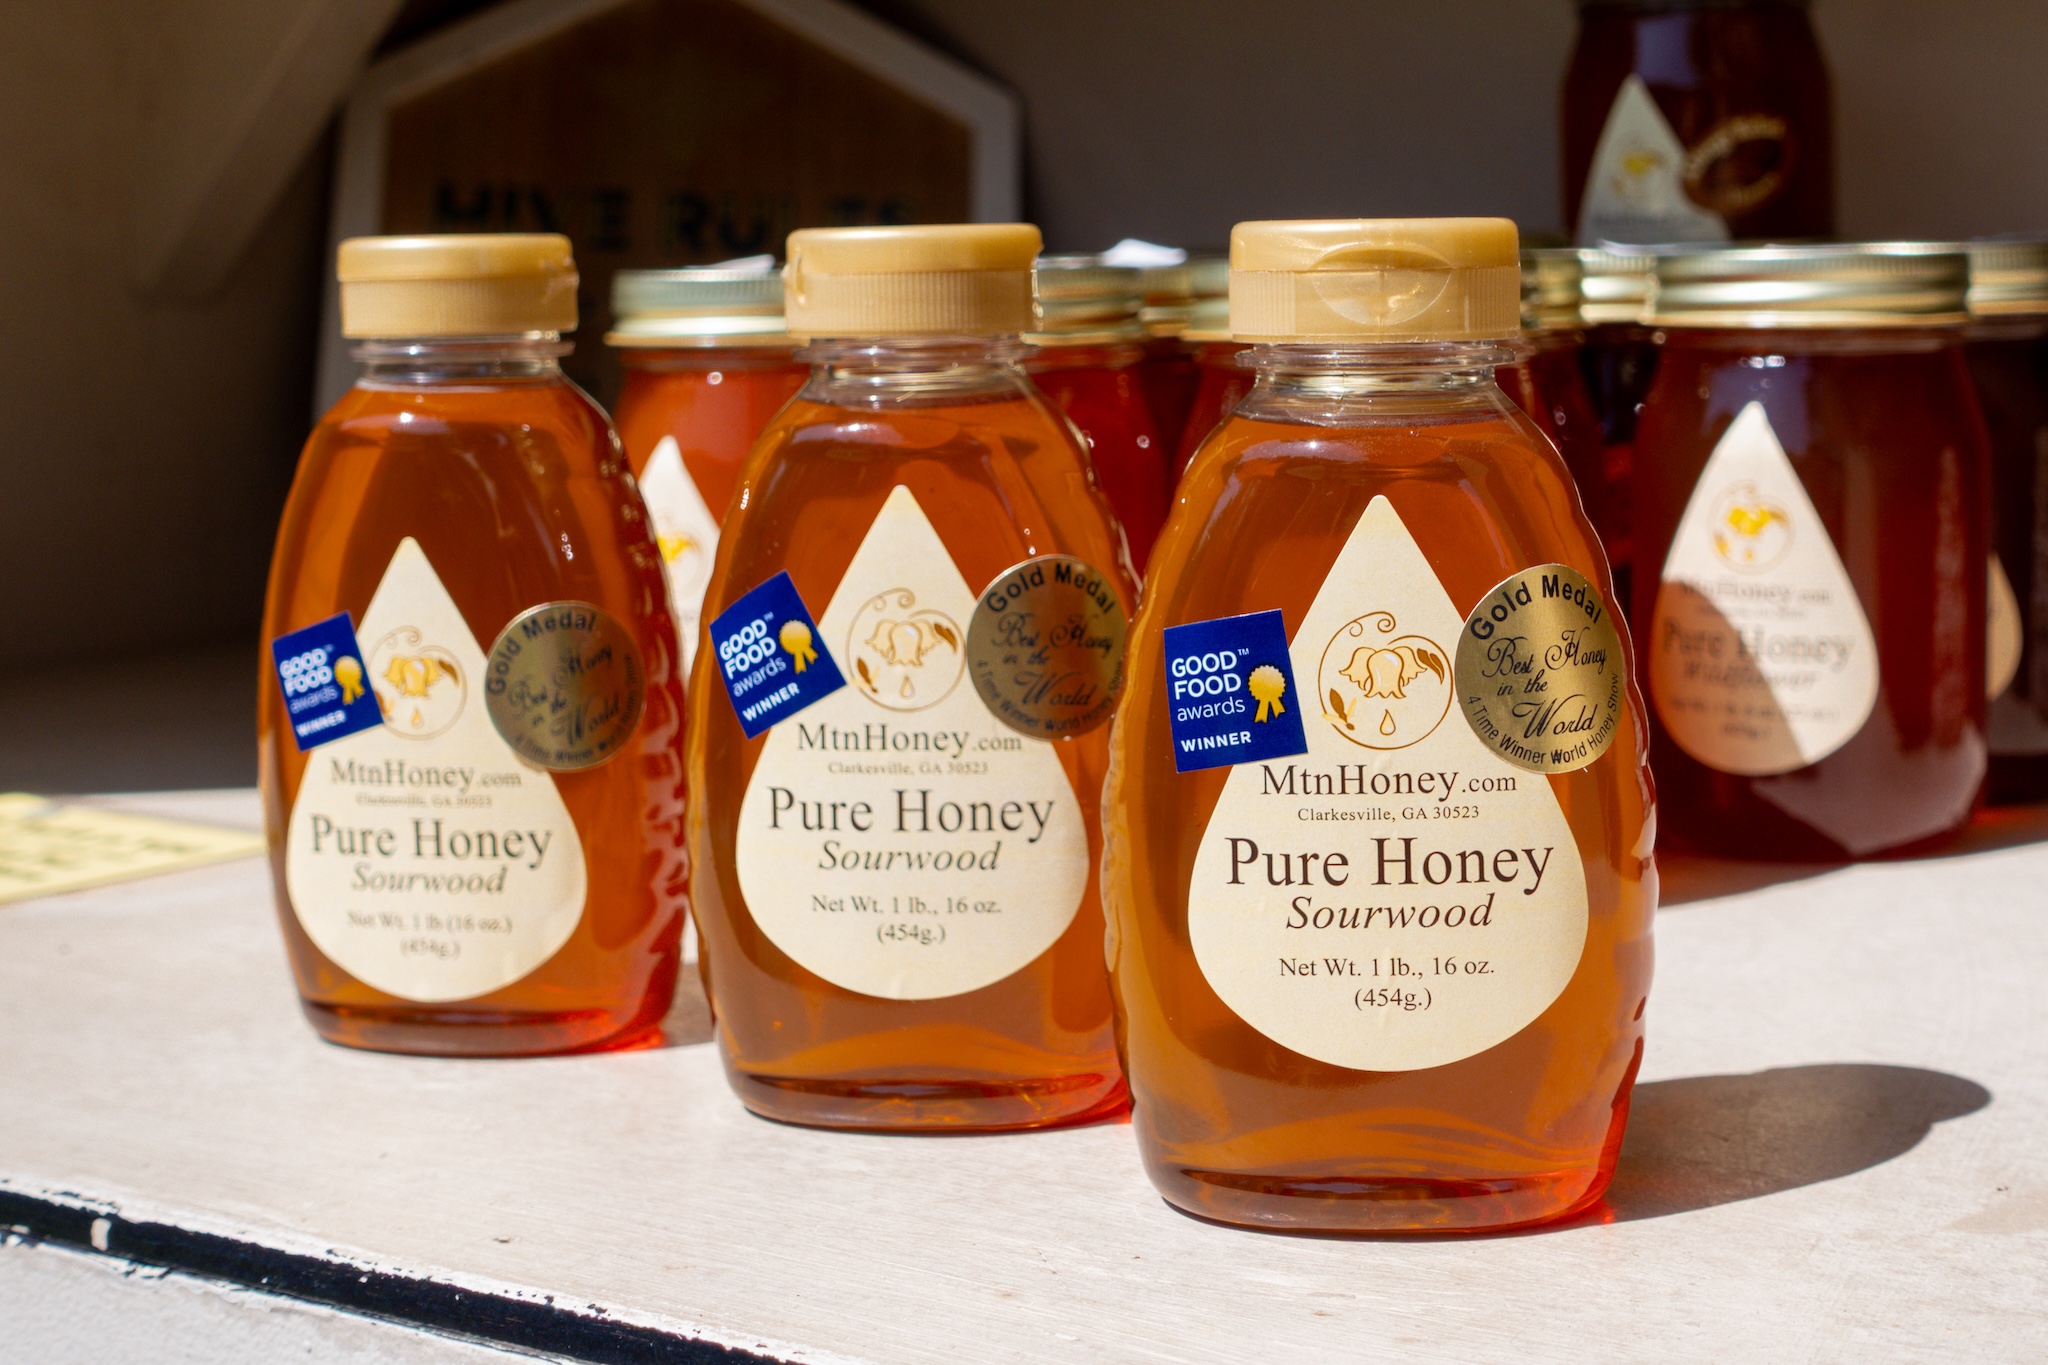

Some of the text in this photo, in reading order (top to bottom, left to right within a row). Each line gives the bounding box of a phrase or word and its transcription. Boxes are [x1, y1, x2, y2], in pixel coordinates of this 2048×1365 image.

[986, 563, 1115, 614] Gold Medal
[1470, 575, 1601, 640] Gold Medal
[486, 611, 597, 696] Gold Medal
[720, 619, 767, 660] GOOD
[1482, 627, 1607, 678] Best Honey
[280, 648, 327, 679] GOOD
[725, 637, 776, 680] FOOD
[1172, 651, 1237, 677] GOOD
[284, 666, 332, 697] FOOD
[732, 657, 787, 697] awards
[1174, 673, 1241, 700] FOOD
[1497, 669, 1548, 696] in the
[290, 685, 338, 713] awards
[743, 682, 800, 721] WINNER
[1177, 697, 1245, 721] awards
[296, 710, 346, 737] WINNER
[1468, 672, 1618, 765] 4 Time Winner World Honey Show
[1512, 694, 1598, 738] World
[1181, 731, 1251, 752] WINNER
[919, 762, 942, 775] GA
[767, 786, 1055, 843] Pure Honey
[1298, 806, 1480, 823] Clarkesville, GA 30523
[310, 813, 552, 870] Pure Honey
[819, 840, 1002, 871] Sourwood
[351, 862, 508, 894] Sourwood
[1224, 837, 1554, 895] Pure Honey
[812, 895, 844, 913] Net
[851, 896, 883, 913] Wt.
[892, 897, 900, 913] 1
[946, 897, 968, 913] 16
[973, 901, 1002, 913] oz.
[1286, 893, 1495, 929] Sourwood
[877, 924, 946, 944] (454g.)
[1279, 956, 1495, 979] Net Wt. 1 lb., 16 oz.
[1355, 987, 1432, 1011] (454g.)
